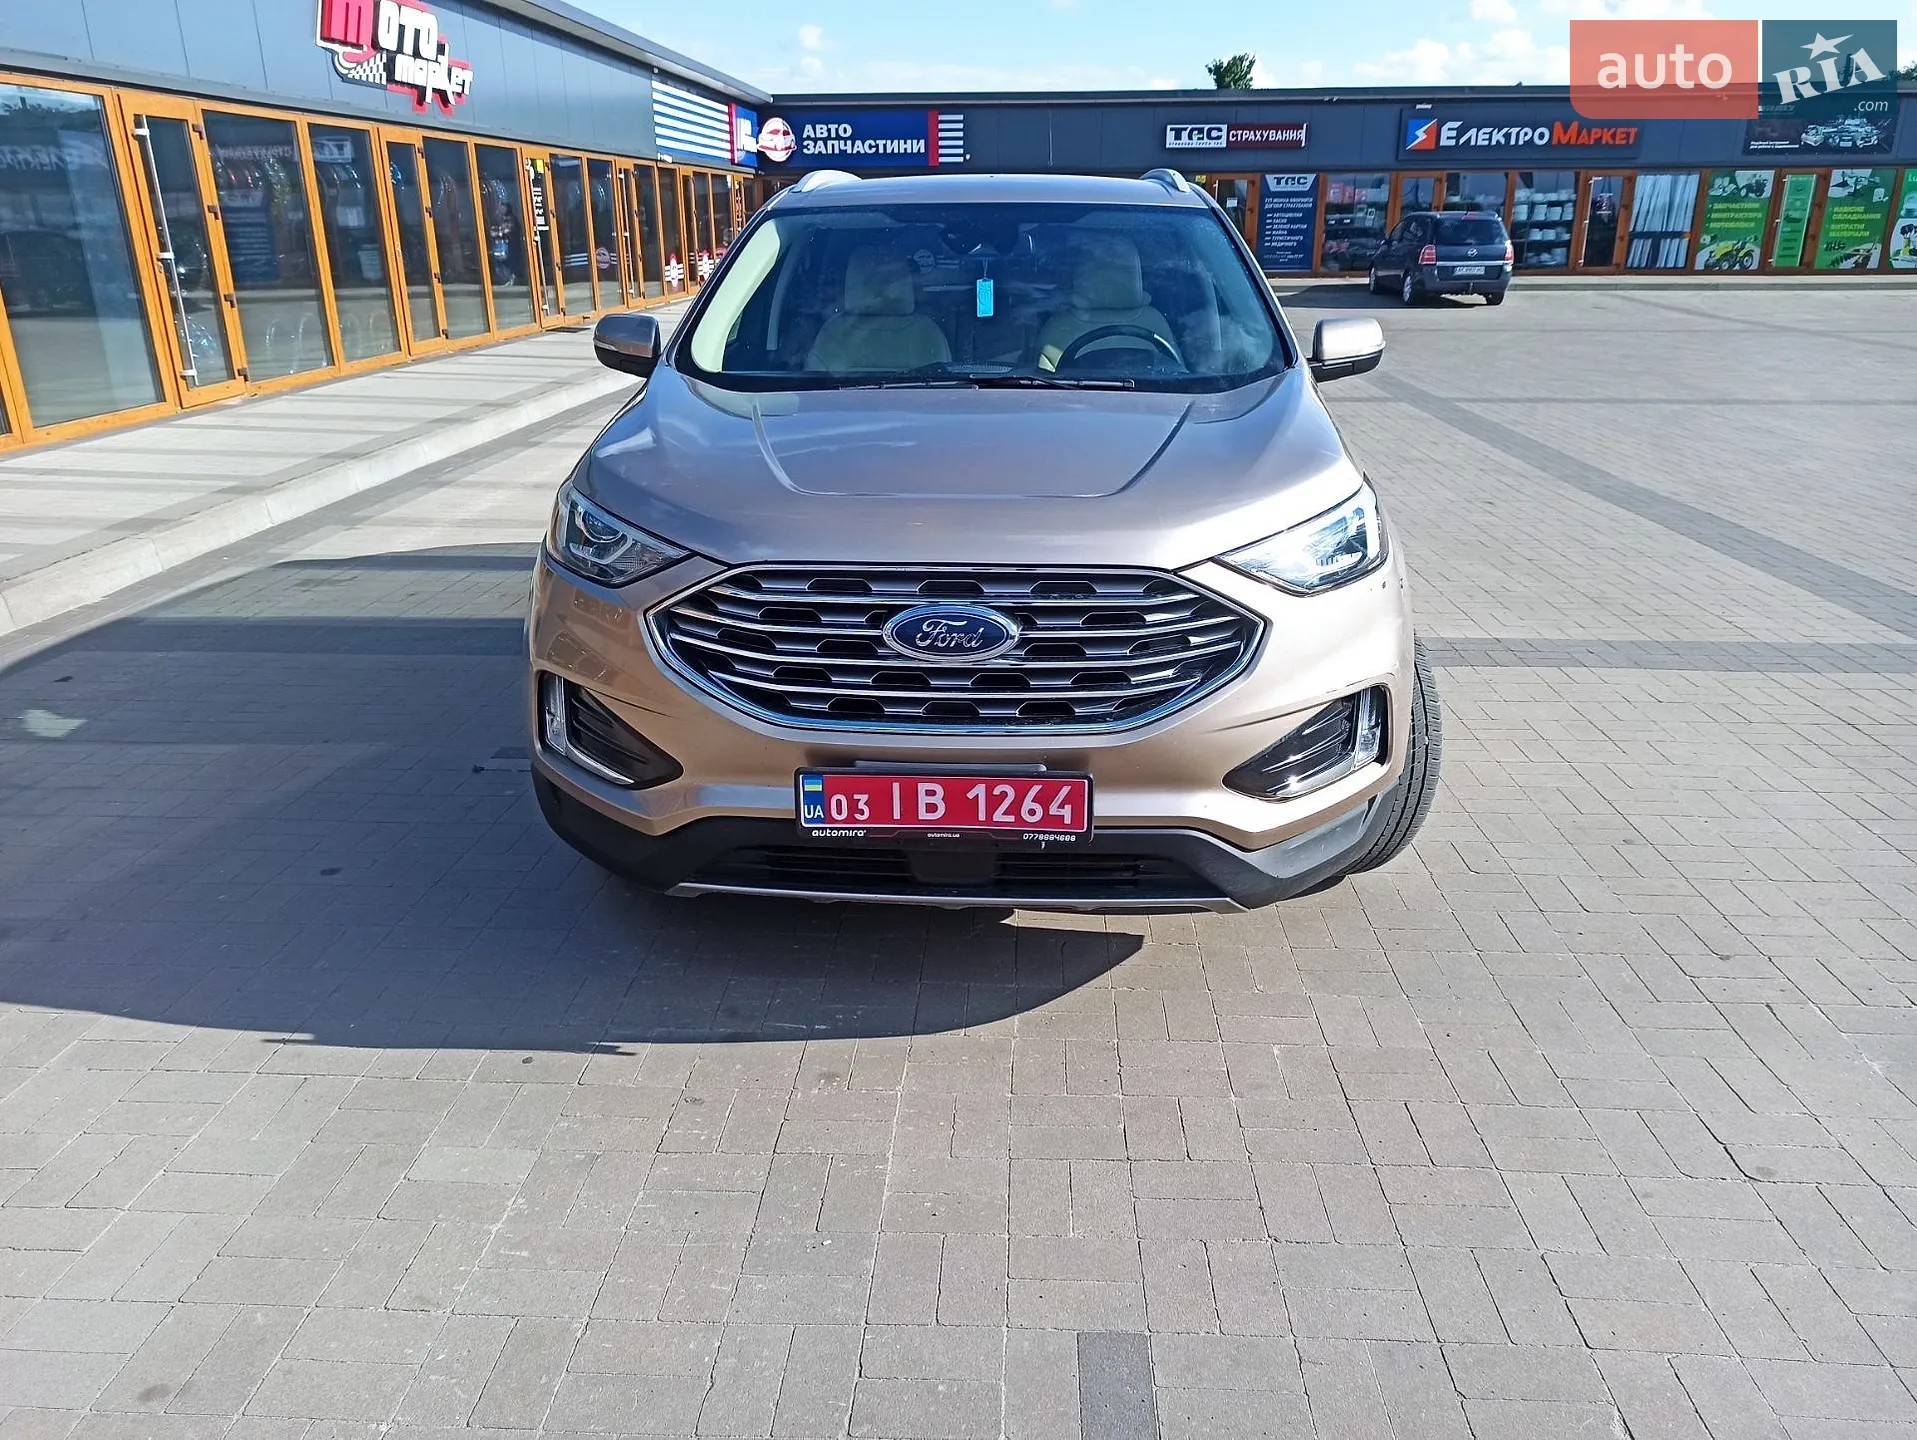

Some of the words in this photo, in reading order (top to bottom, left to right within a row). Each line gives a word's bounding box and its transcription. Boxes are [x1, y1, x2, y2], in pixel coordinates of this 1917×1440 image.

[803, 123, 853, 139] АВТО
[1229, 129, 1304, 142] СТРАХУВАННЯ
[803, 139, 926, 155] ЗАПЧАСТИНИ
[916, 618, 985, 647] Ford
[804, 804, 824, 819] UA
[830, 794, 870, 820] 03
[966, 784, 1072, 825] 1264
